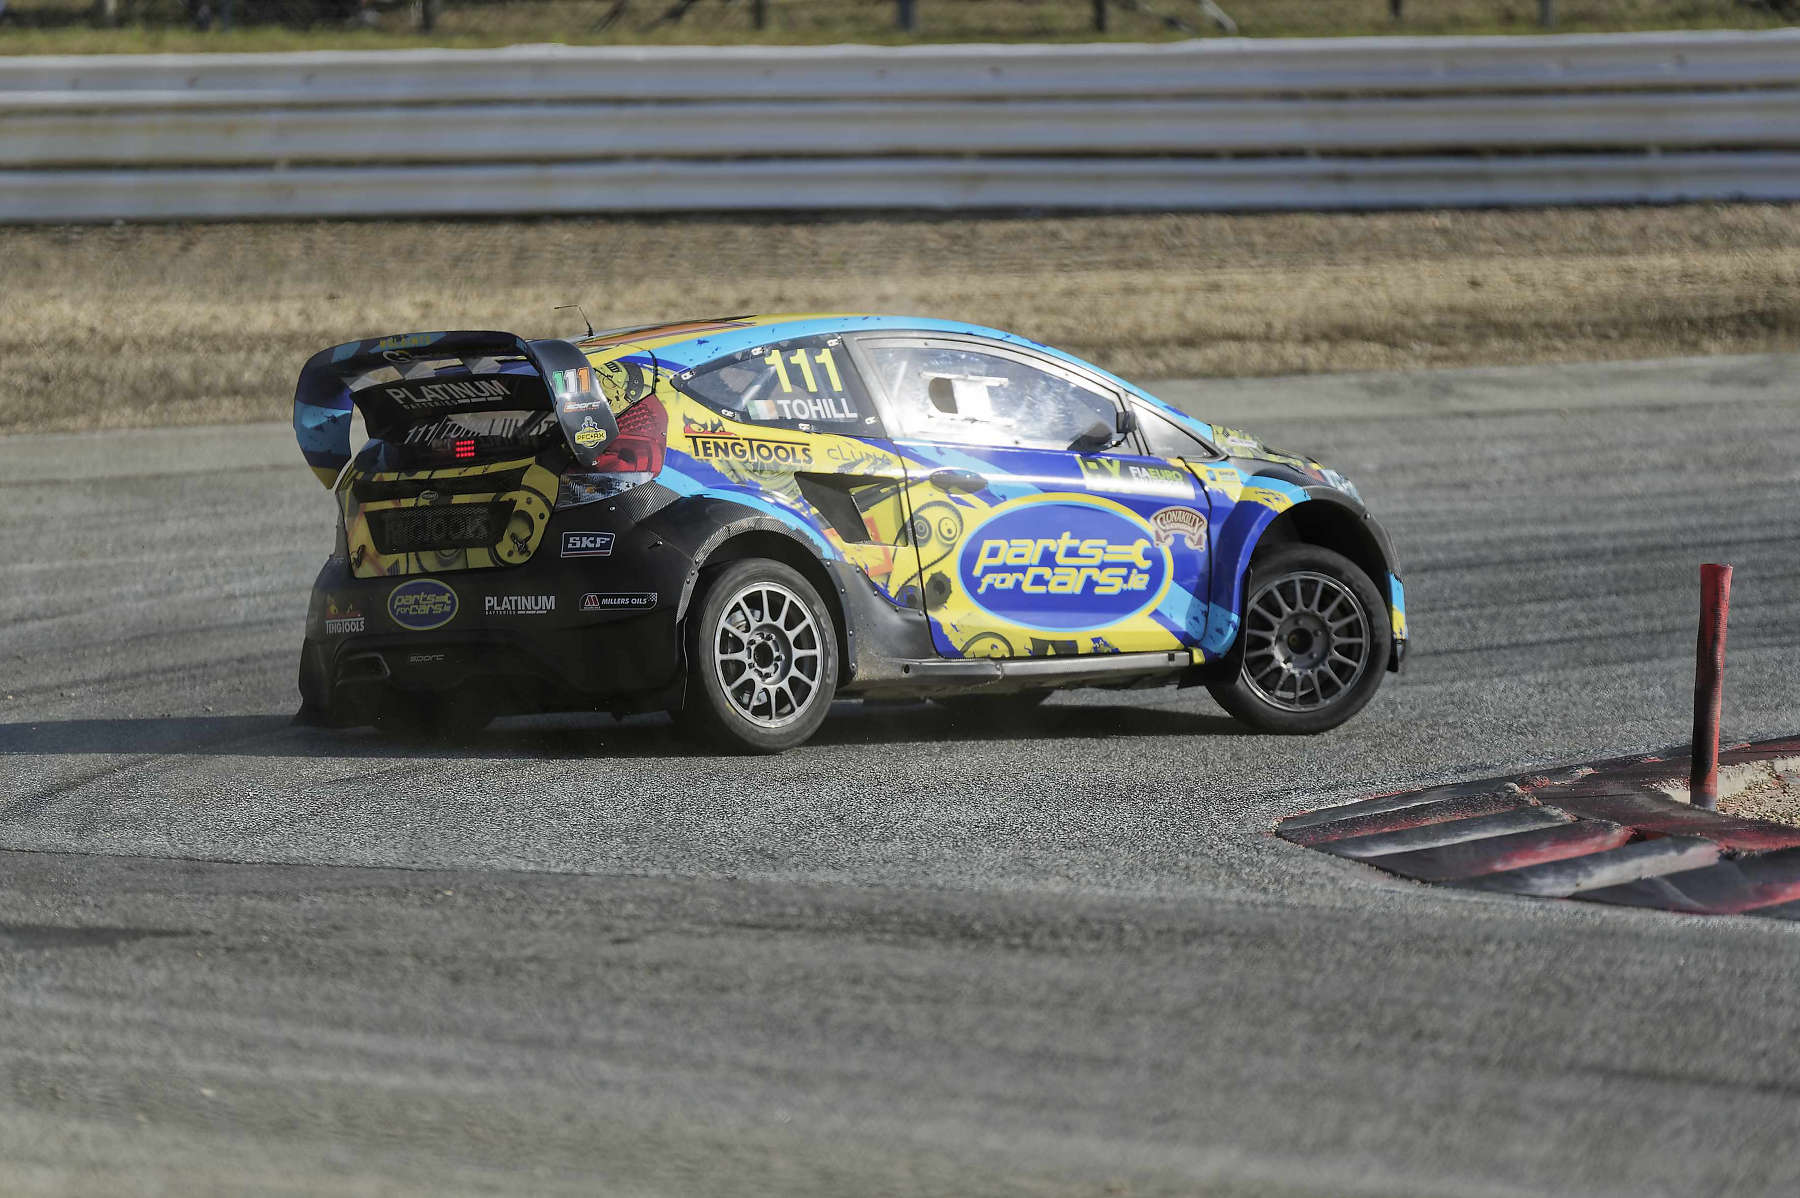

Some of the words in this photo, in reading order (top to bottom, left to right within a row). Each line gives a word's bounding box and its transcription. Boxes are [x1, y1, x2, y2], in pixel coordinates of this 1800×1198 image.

[553, 367, 590, 393] 111
[764, 348, 842, 393] 111
[385, 379, 511, 404] PLATINUM
[777, 398, 858, 420] TOHILL
[568, 536, 611, 548] SKF
[973, 531, 1107, 576] parts
[485, 595, 556, 611] PLATINUM
[631, 597, 648, 605] OILS
